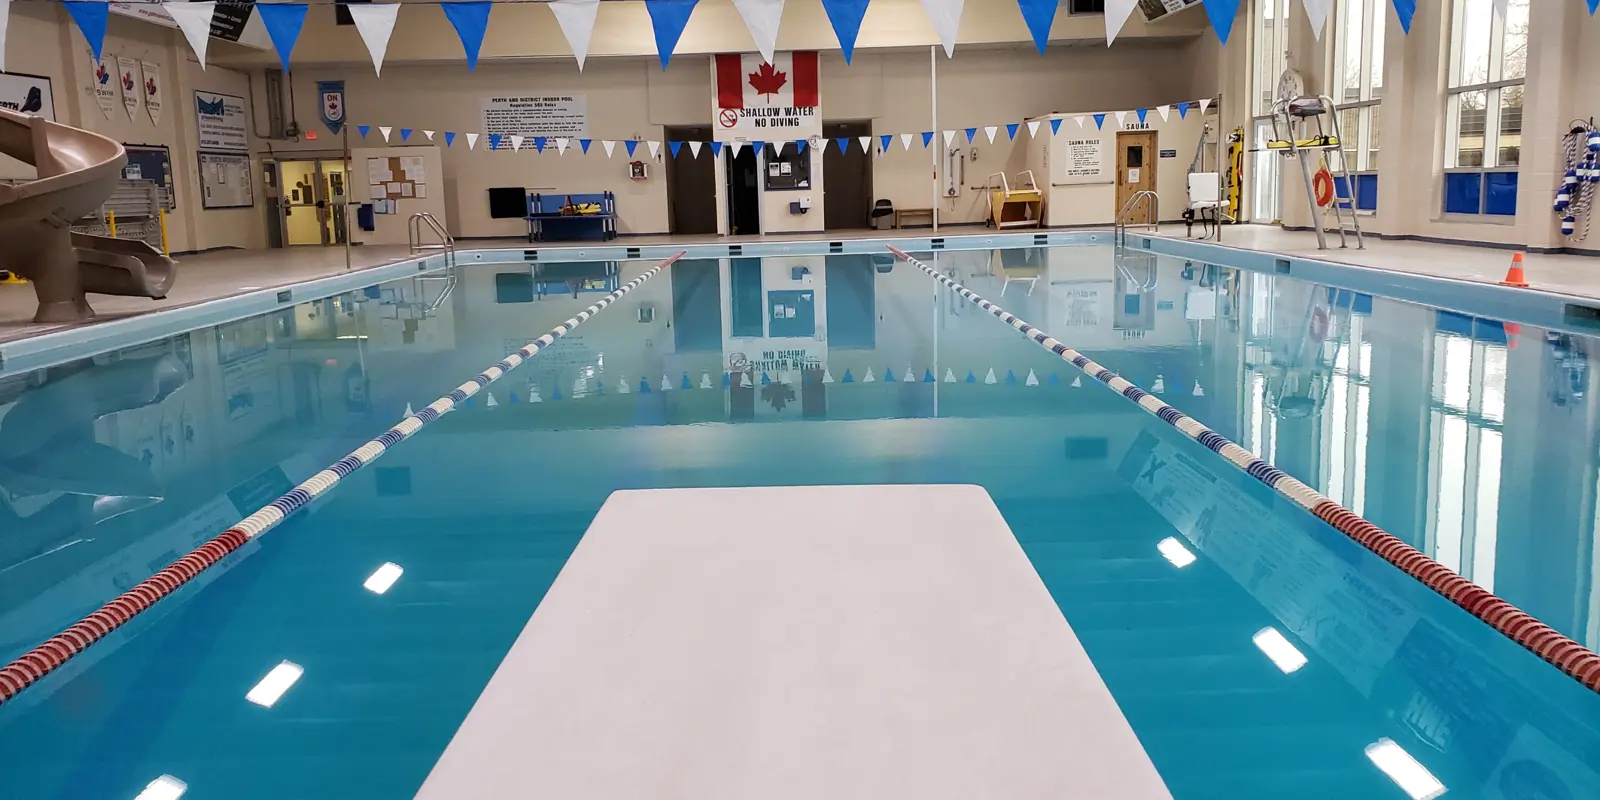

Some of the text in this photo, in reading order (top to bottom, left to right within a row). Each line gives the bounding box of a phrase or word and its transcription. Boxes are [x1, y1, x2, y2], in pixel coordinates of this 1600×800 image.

[740, 106, 814, 118] SHALLOW WATER
[755, 118, 800, 128] NO DIVING
